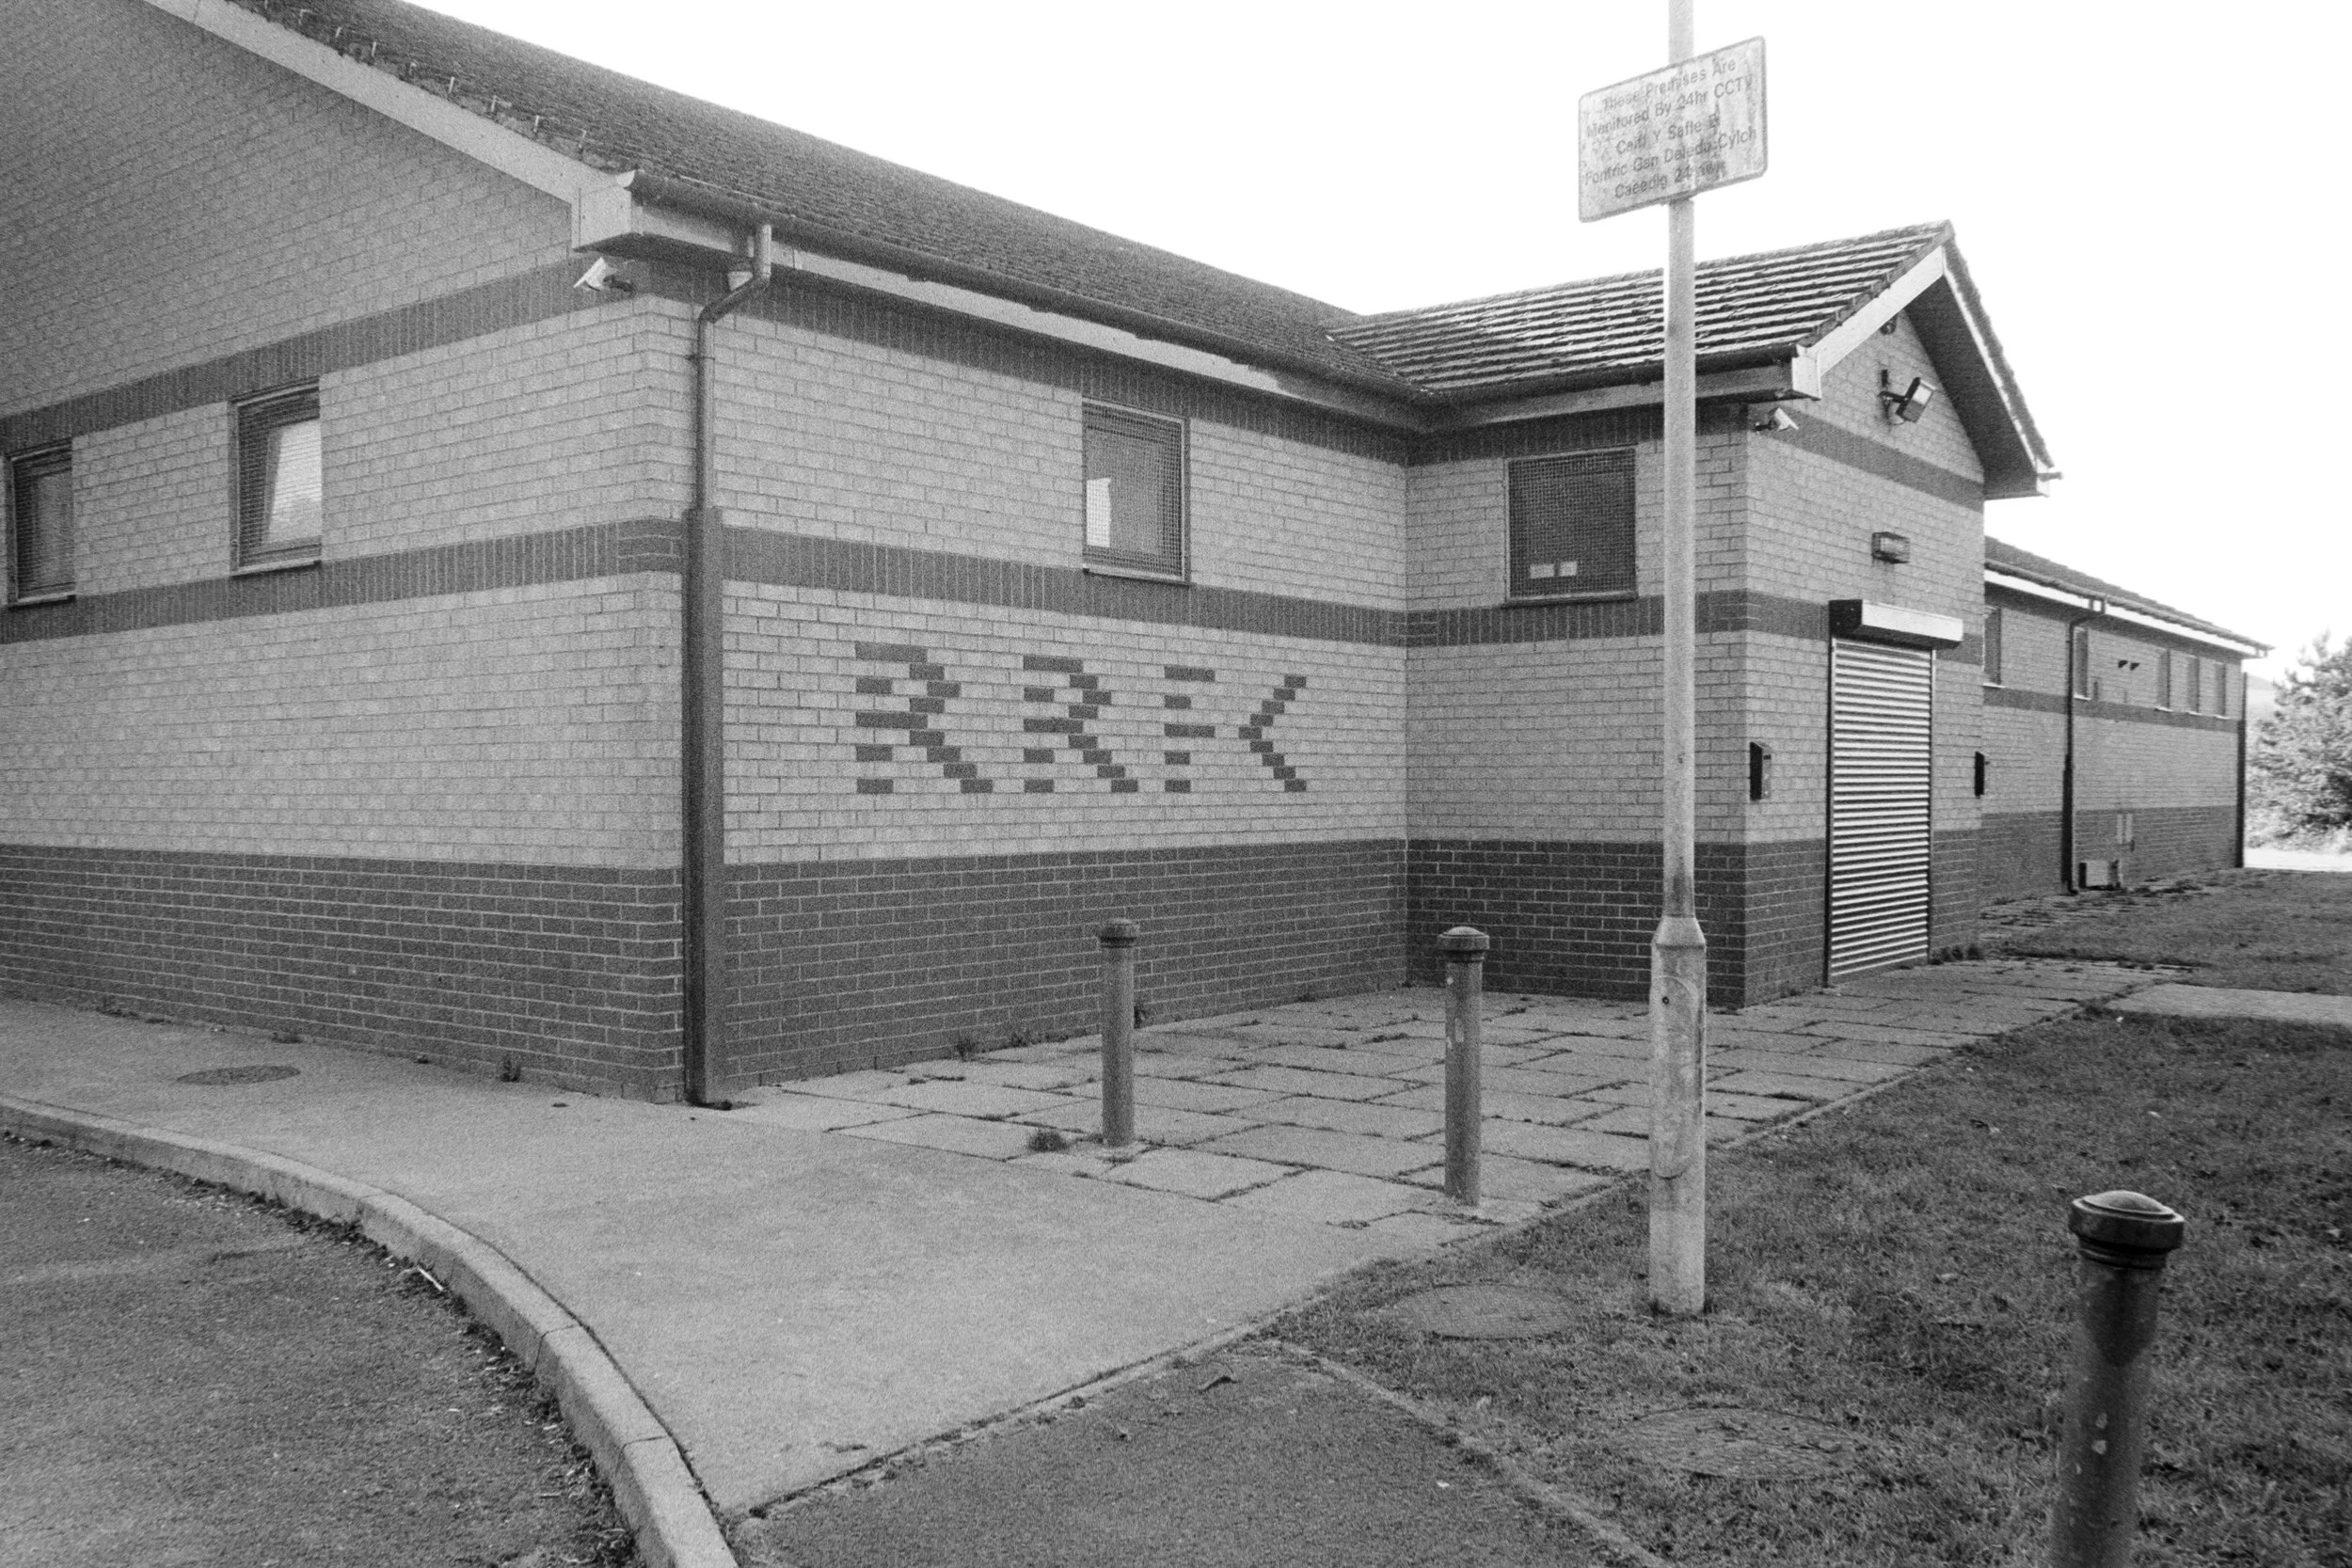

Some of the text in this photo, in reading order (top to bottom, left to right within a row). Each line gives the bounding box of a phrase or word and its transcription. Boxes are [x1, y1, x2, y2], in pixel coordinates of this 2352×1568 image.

[1586, 75, 1754, 137] Monitored By 24hr CCTV
[1602, 59, 1737, 111] These Premises Are
[1633, 154, 1659, 172] Gan
[1717, 125, 1757, 150] Cylch
[1653, 129, 1661, 142] Y
[1674, 164, 1692, 183] 24
